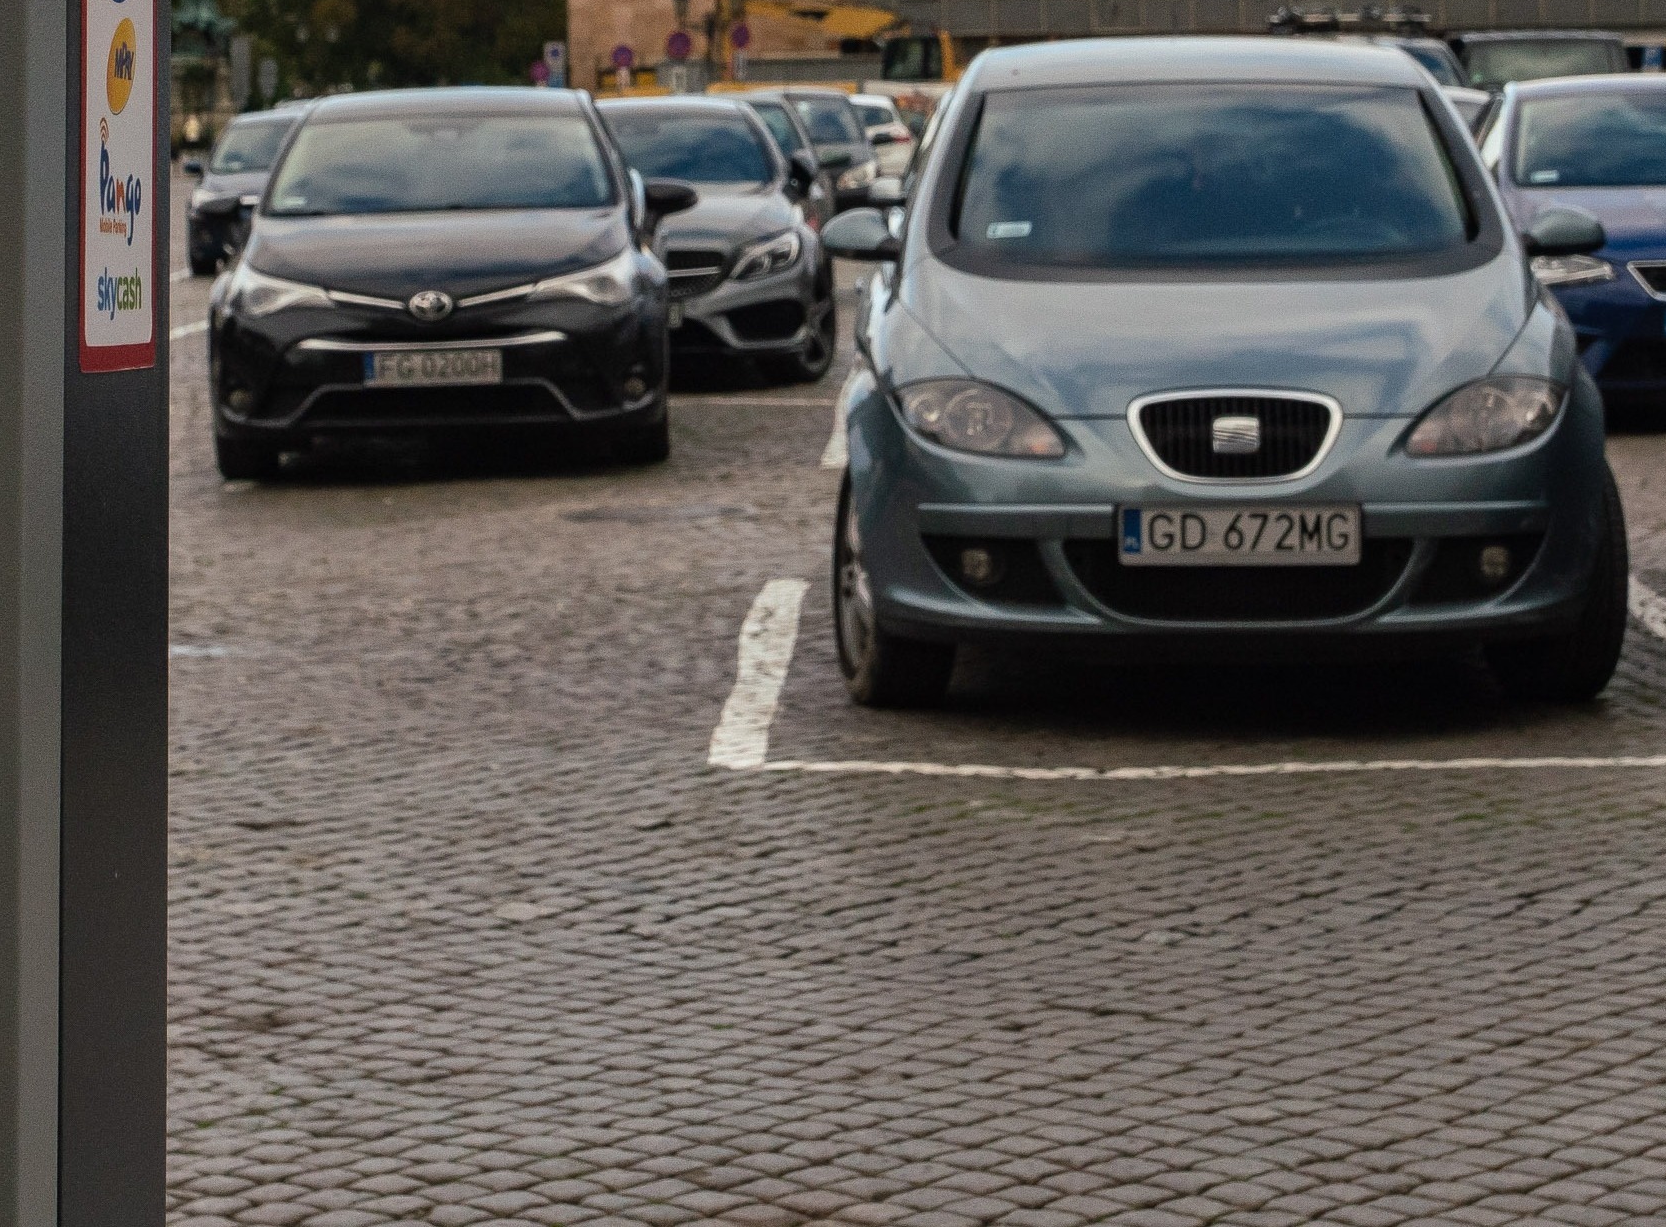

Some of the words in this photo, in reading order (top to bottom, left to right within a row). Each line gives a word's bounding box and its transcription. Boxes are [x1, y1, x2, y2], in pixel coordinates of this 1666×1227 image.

[100, 141, 141, 246] Pango
[97, 267, 141, 321] skycash
[1148, 514, 1206, 551] GD
[1224, 514, 1348, 550] 672MG
